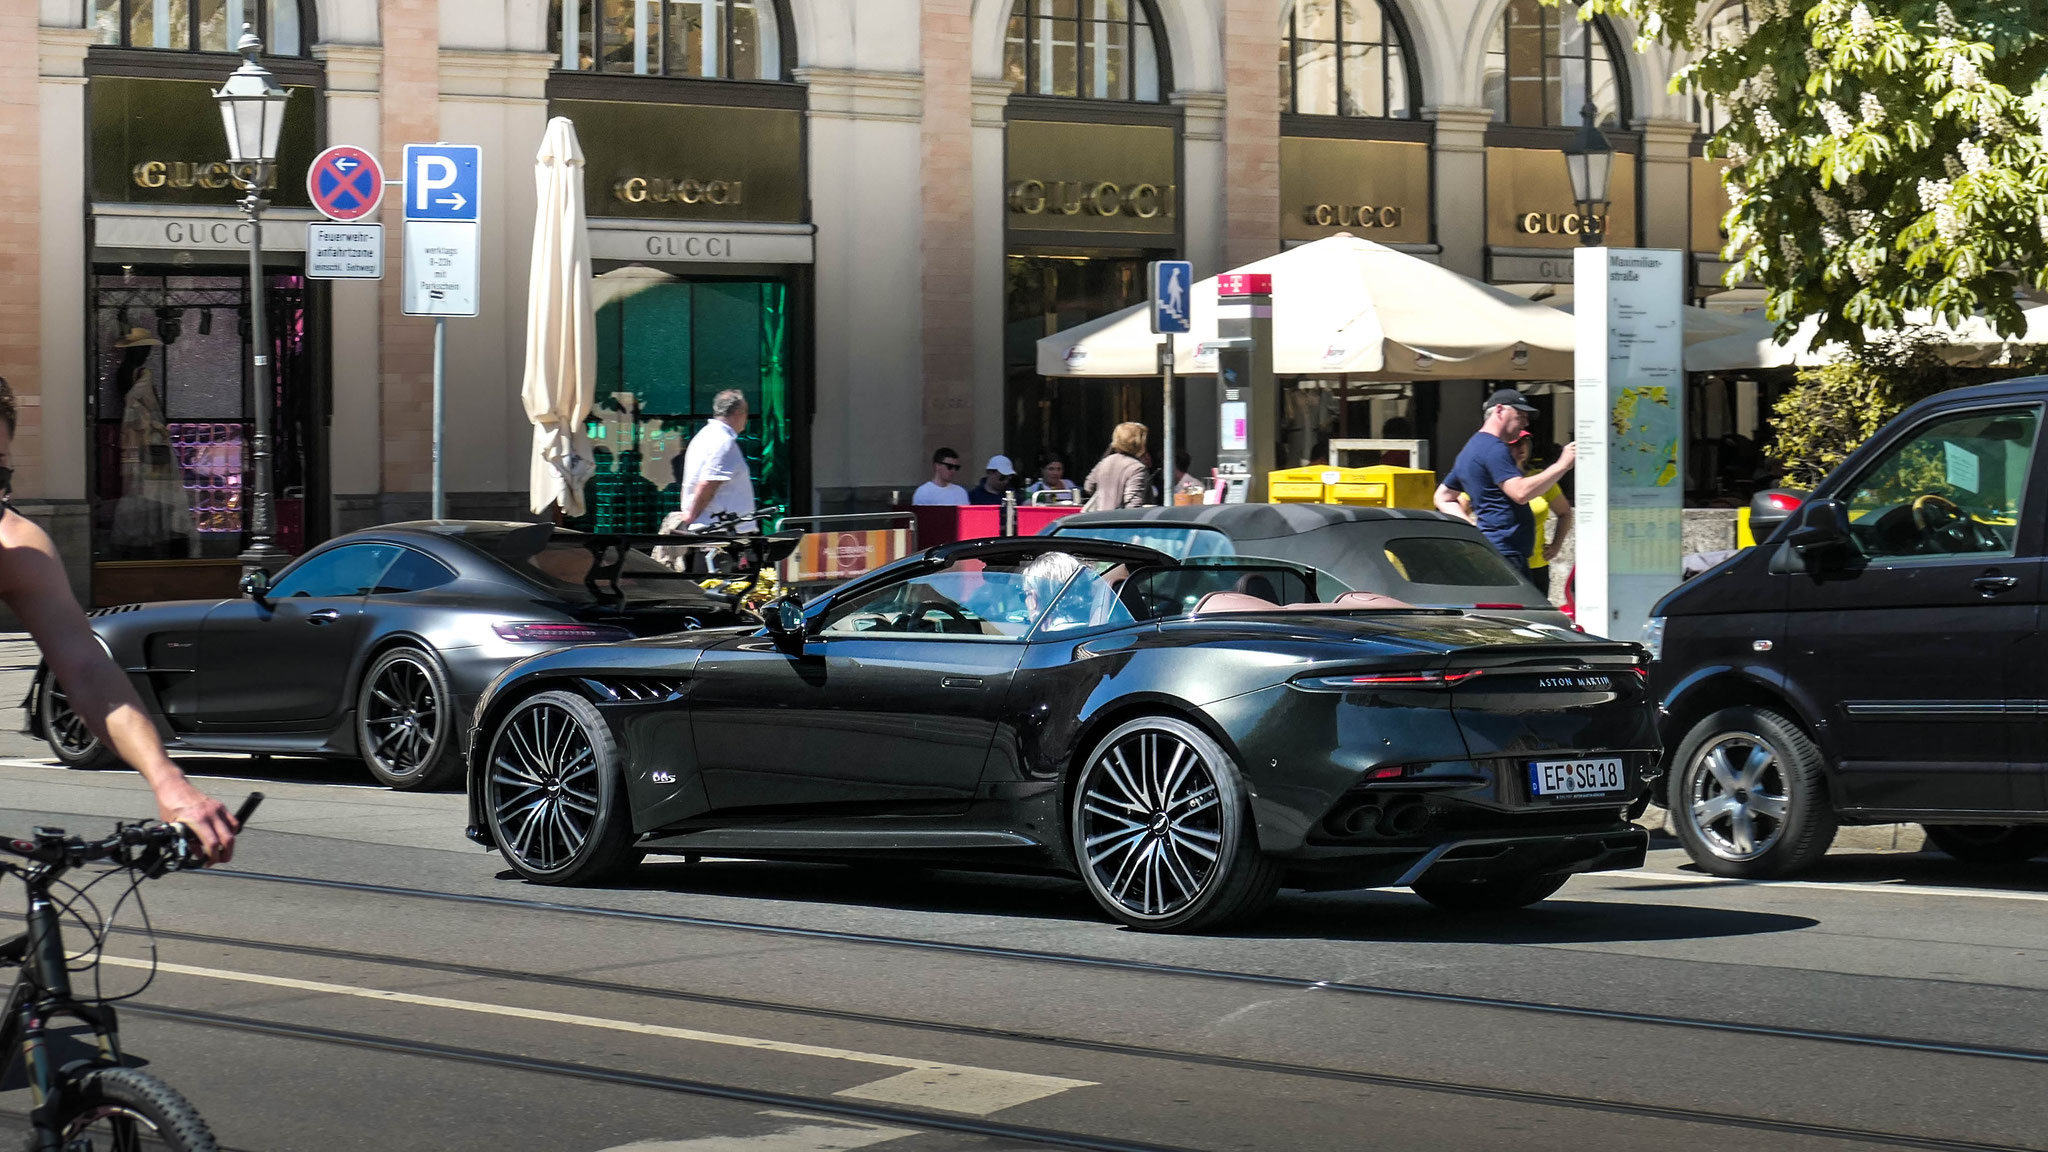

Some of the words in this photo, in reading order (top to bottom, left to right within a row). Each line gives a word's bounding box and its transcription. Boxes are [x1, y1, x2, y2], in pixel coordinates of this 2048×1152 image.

[416, 155, 458, 210] P
[618, 177, 742, 205] GUCCI
[1014, 179, 1176, 219] GUCCI
[1315, 204, 1405, 228] GUCCI
[165, 222, 262, 245] GUCC
[318, 230, 374, 242] Feuerwehr-
[317, 247, 374, 258] anfahrtzone
[646, 236, 731, 257] GUCCI
[1609, 256, 1663, 268] Maximilian-
[1609, 270, 1639, 282] straße
[1540, 677, 1573, 688] ASTON
[1577, 676, 1610, 687] MARTIN
[1544, 765, 1565, 791] EF
